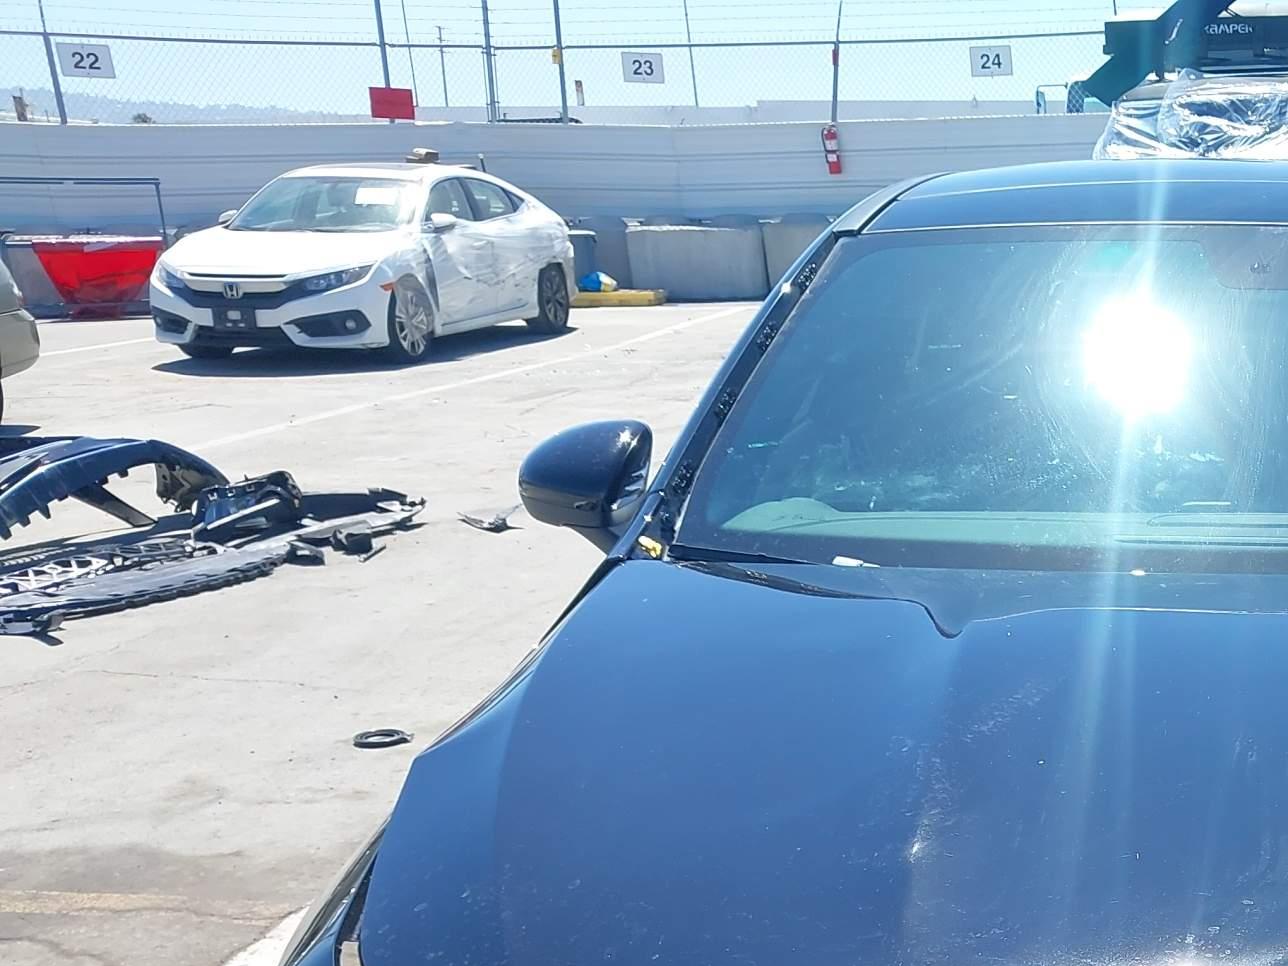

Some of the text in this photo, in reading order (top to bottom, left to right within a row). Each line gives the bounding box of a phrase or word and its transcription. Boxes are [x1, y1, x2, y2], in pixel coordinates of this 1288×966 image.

[71, 51, 102, 70] 22
[632, 59, 654, 77] 23
[980, 53, 1002, 70] 24
